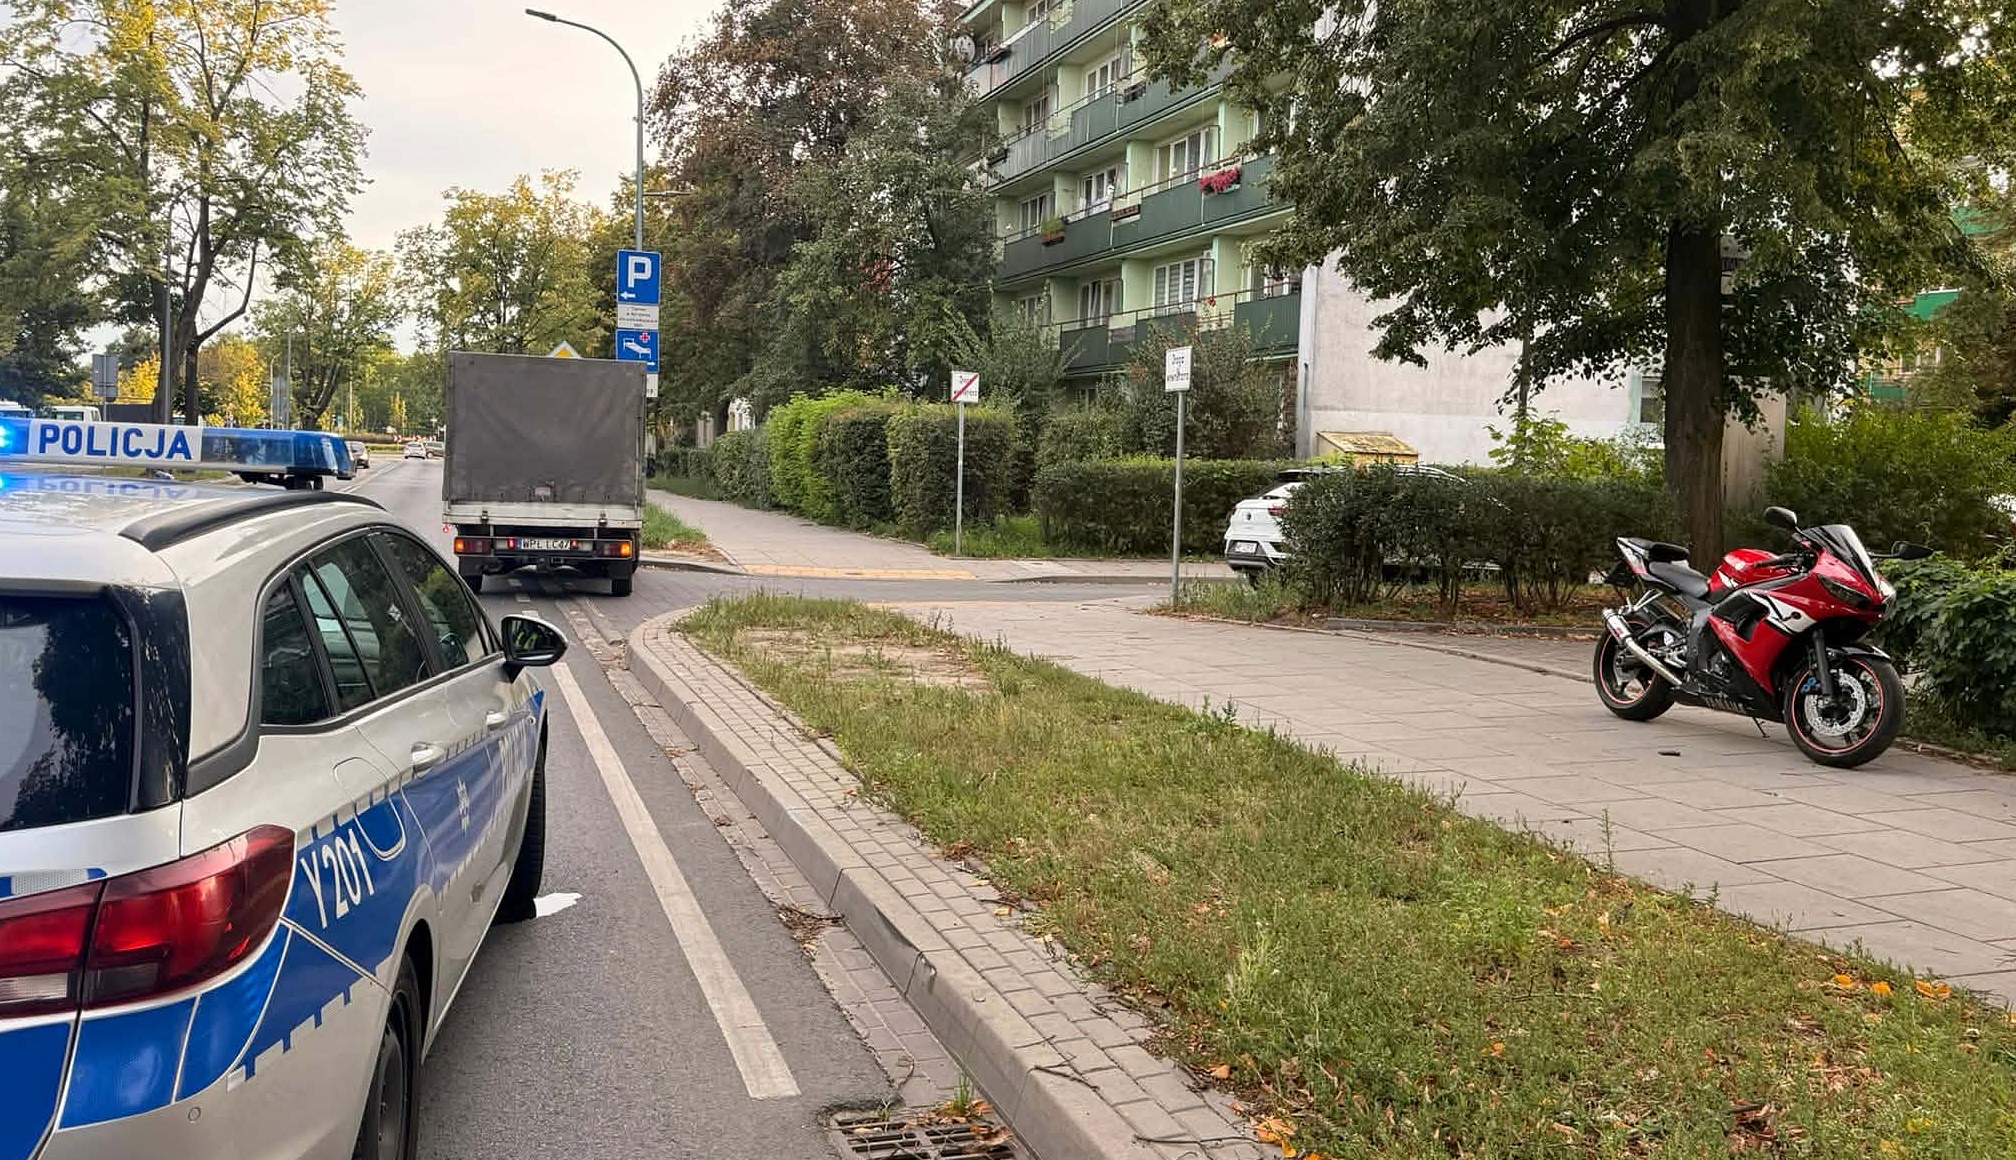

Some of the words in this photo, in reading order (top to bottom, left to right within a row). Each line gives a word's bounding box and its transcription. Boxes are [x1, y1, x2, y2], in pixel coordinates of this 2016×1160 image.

[627, 255, 652, 288] P
[39, 424, 192, 460] POLICJA
[300, 828, 375, 929] Y201
